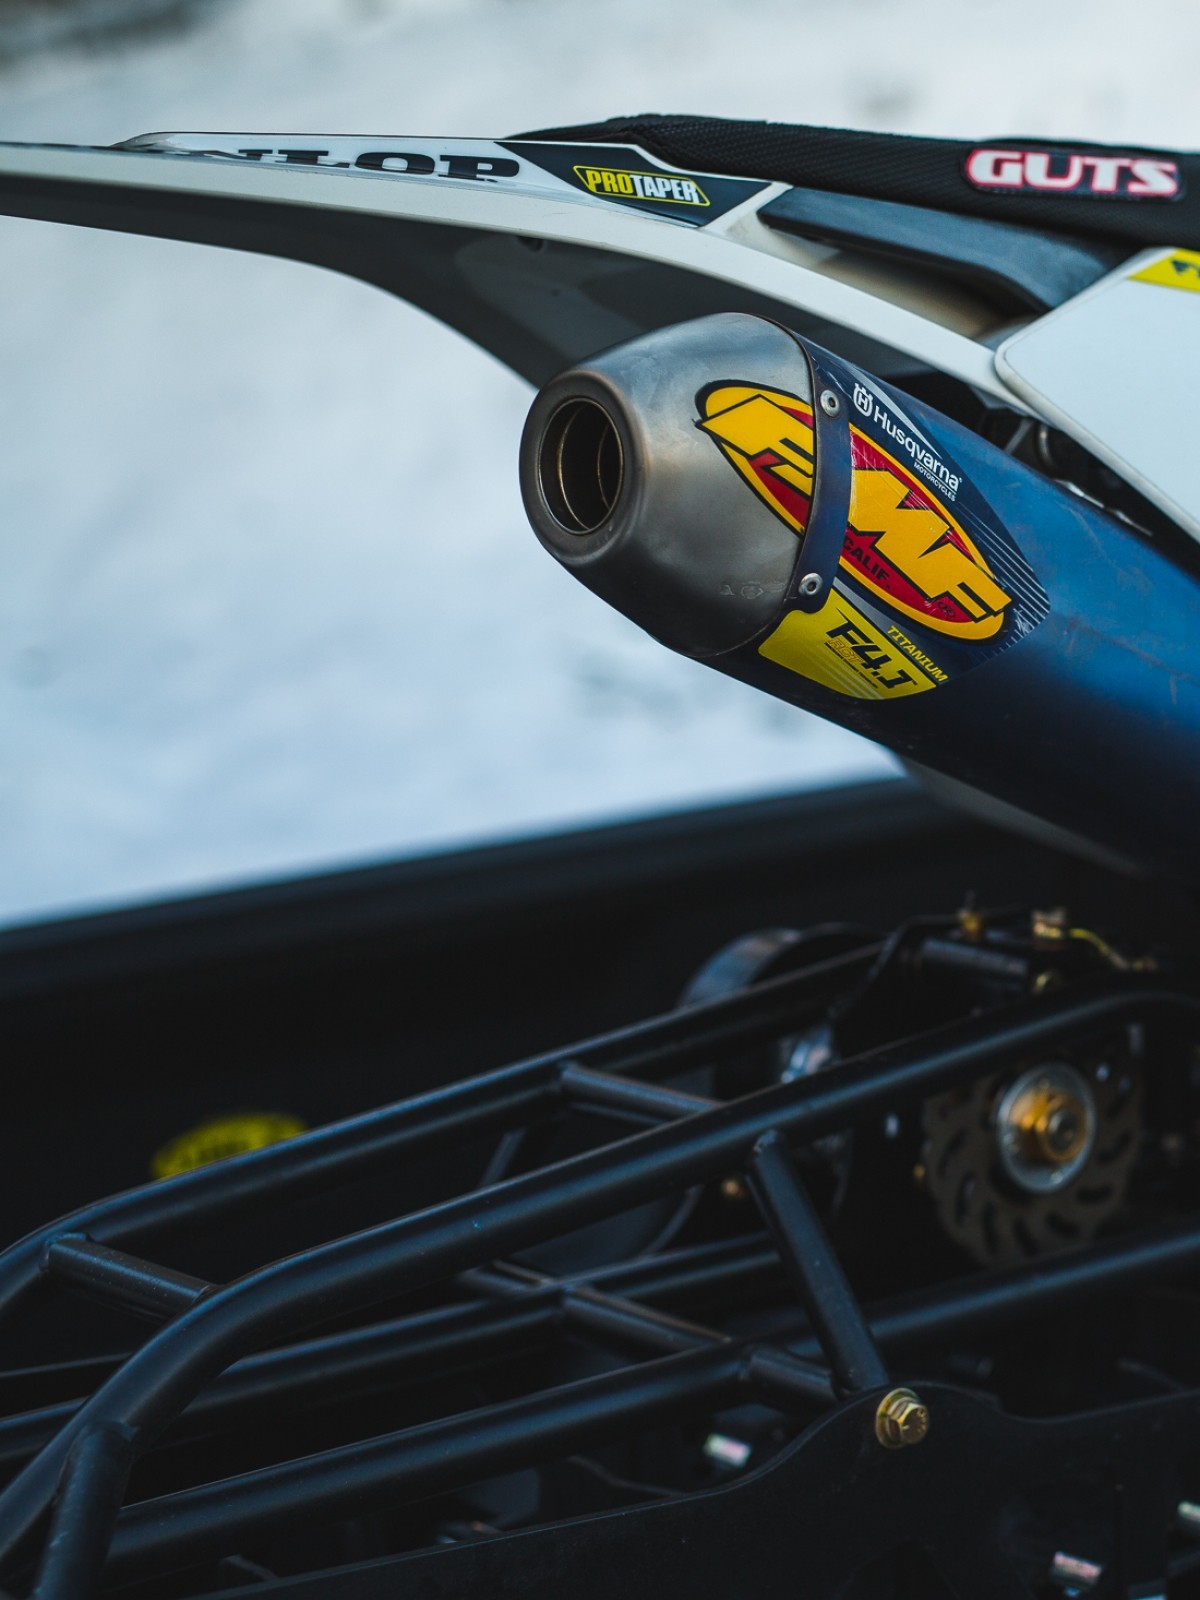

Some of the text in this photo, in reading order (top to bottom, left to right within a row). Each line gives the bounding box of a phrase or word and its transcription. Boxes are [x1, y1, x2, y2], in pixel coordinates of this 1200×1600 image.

[585, 169, 700, 204] PROTAPER
[966, 149, 1179, 195] GUTS
[873, 405, 960, 491] Husqvarna
[913, 461, 956, 502] MOTORCYCLES
[843, 534, 893, 590] CALIF.
[887, 625, 948, 682] TITANIUM
